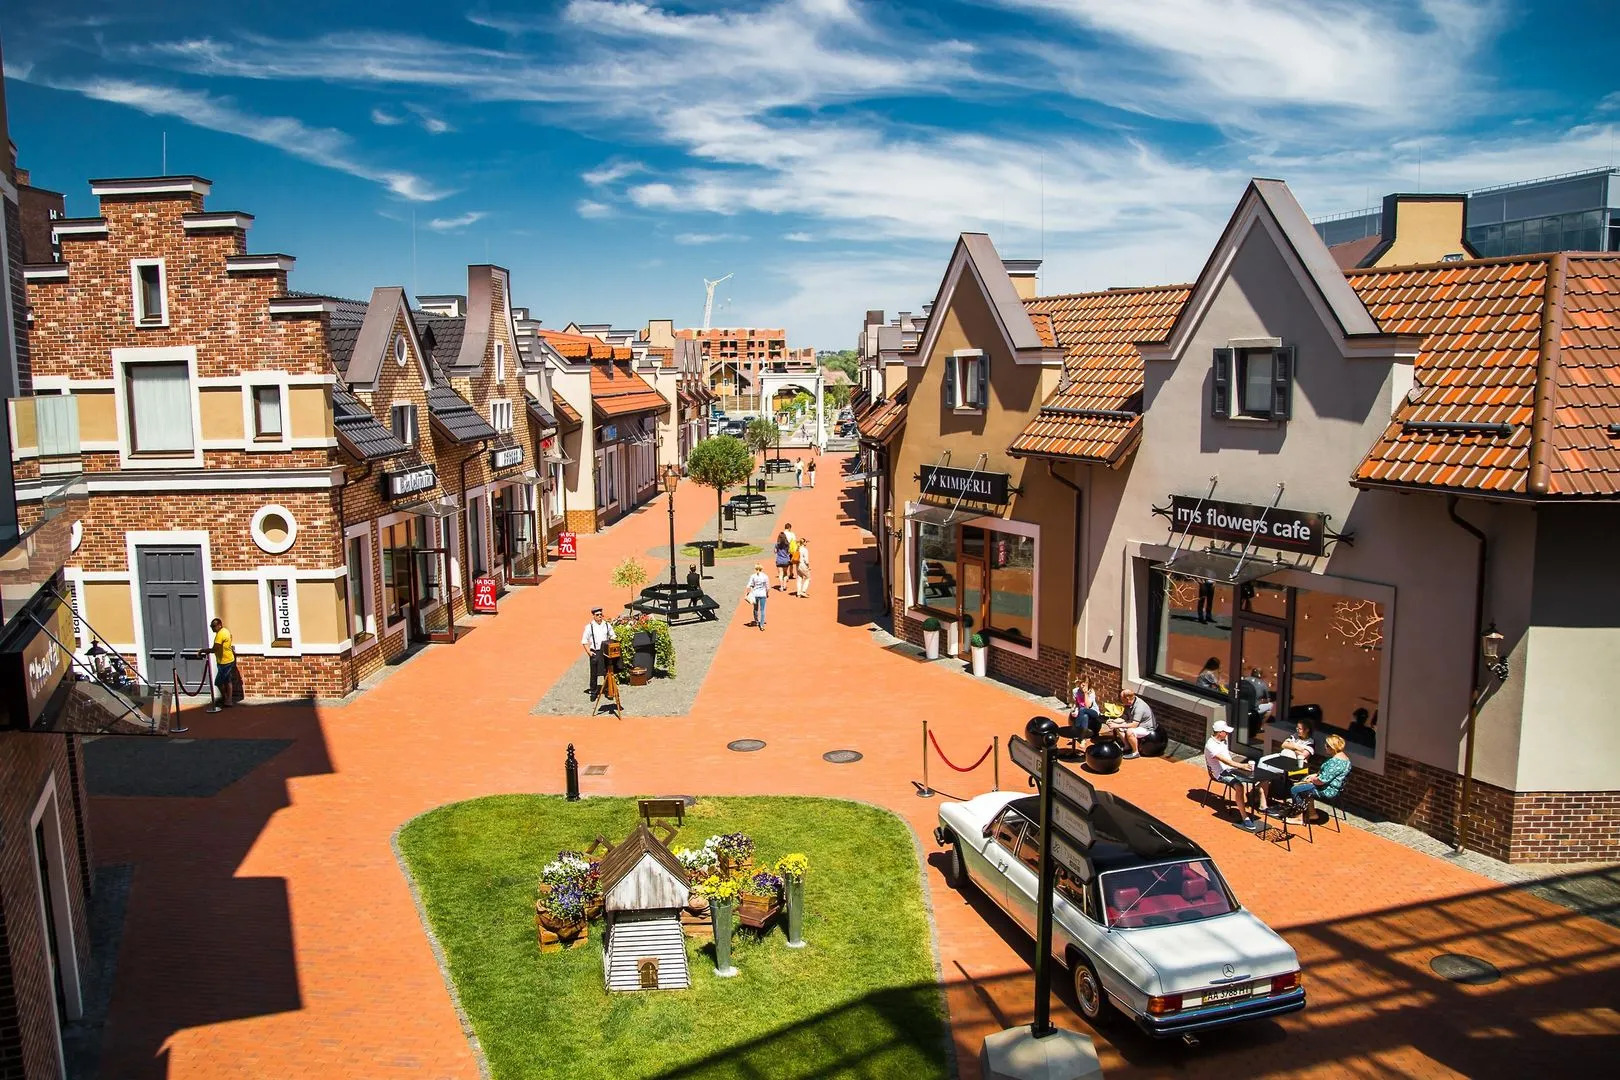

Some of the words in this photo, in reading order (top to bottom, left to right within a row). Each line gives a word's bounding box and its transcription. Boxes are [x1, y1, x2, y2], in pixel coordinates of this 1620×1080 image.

[940, 475, 992, 494] KIMBERLI
[1206, 508, 1268, 534] flowers
[1272, 519, 1311, 541] cafe
[277, 584, 291, 634] Baldinini
